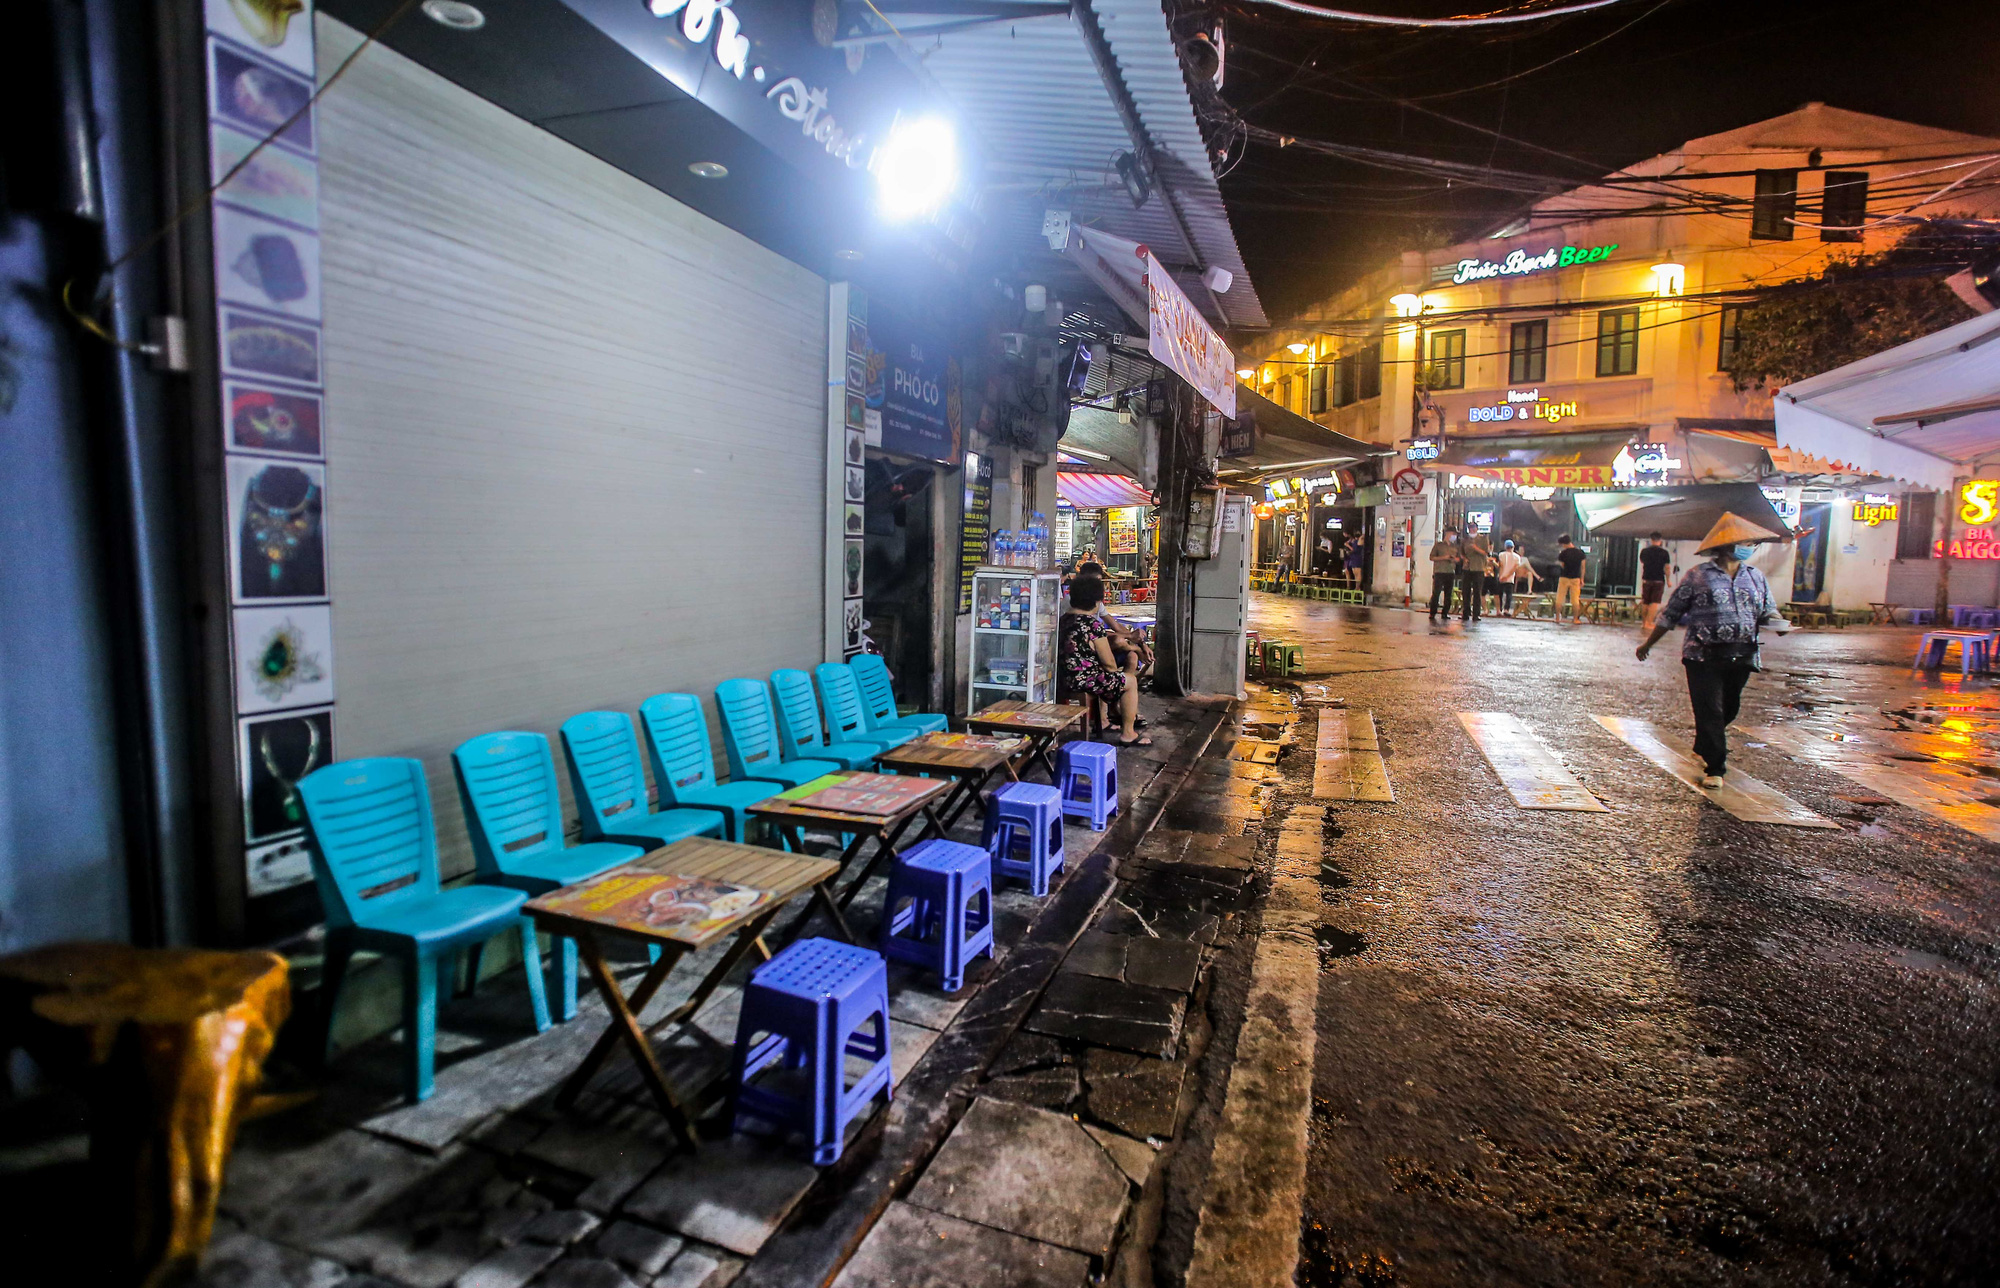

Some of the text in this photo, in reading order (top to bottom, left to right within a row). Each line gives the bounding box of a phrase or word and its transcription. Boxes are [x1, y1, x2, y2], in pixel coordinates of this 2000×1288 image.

[1558, 244, 1619, 267] Beer
[1469, 401, 1578, 423] BOLD & Light
[1406, 447, 1439, 460] BOLD
[1853, 504, 1898, 527] Light
[1965, 528, 1994, 540] BIA
